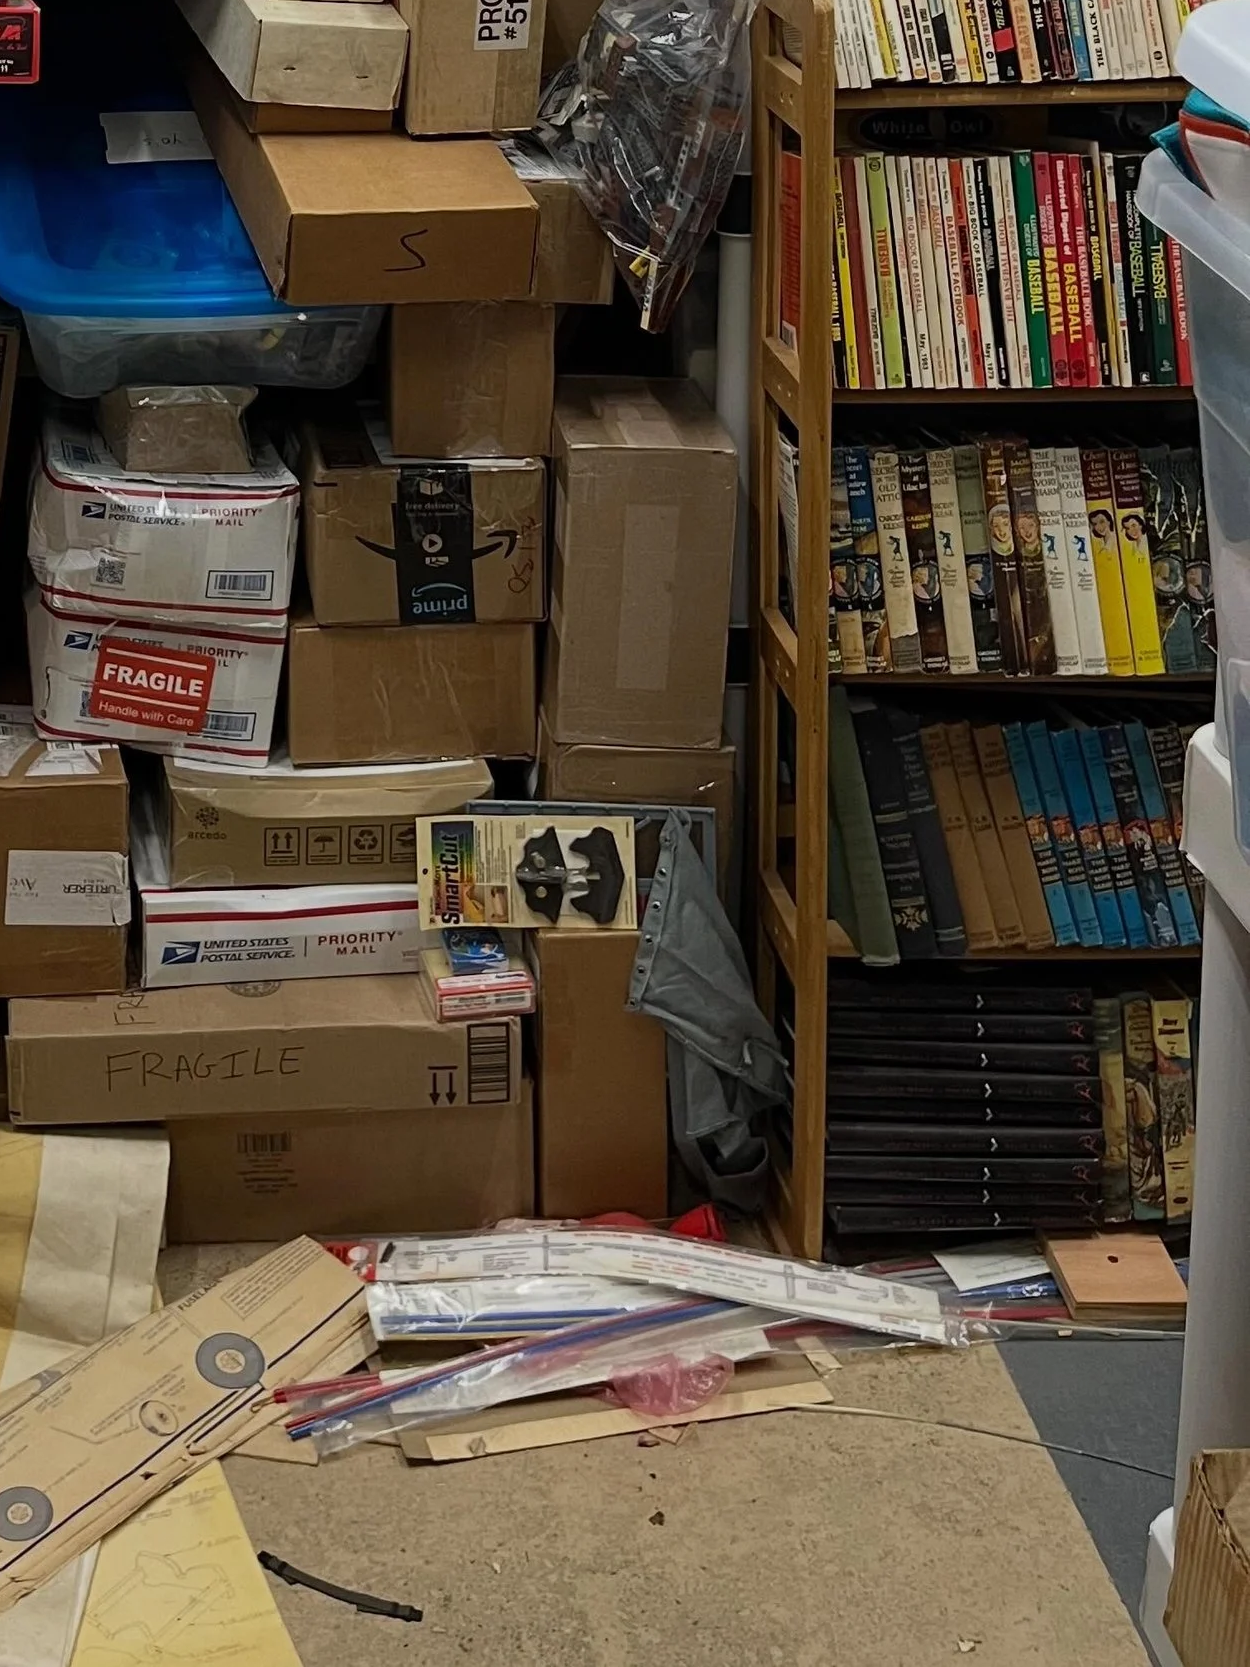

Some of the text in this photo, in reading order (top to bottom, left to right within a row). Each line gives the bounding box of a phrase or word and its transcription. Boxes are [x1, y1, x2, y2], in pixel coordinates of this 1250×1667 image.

[1033, 7, 1045, 30] THE
[1089, 12, 1102, 44] BLACK
[1095, 48, 1105, 68] THE
[870, 121, 926, 136] White
[1056, 160, 1082, 343] Illustrated Digest BASEBALL
[945, 216, 965, 327] BASEBALL FACTBOOK
[974, 257, 985, 297] BASEBALL
[1129, 241, 1145, 297] BASEBALL
[1150, 241, 1167, 299] BASEBALL
[1026, 259, 1045, 314] BASEBALL
[1043, 247, 1064, 335] BASEBALL
[1178, 312, 1188, 340] BOOK
[201, 507, 263, 519] PRIORITY
[215, 517, 245, 528] MAIL
[412, 594, 469, 618] prime
[102, 662, 204, 699] FRAGILE
[98, 700, 195, 728] Handle with Care
[440, 829, 461, 925] SmartCut
[203, 937, 290, 951] UNITED STATES
[317, 931, 398, 948] PRIORITY
[336, 942, 378, 956] MAIL
[200, 948, 293, 965] POSTAL SERVICE
[104, 1045, 307, 1092] FRAGILE
